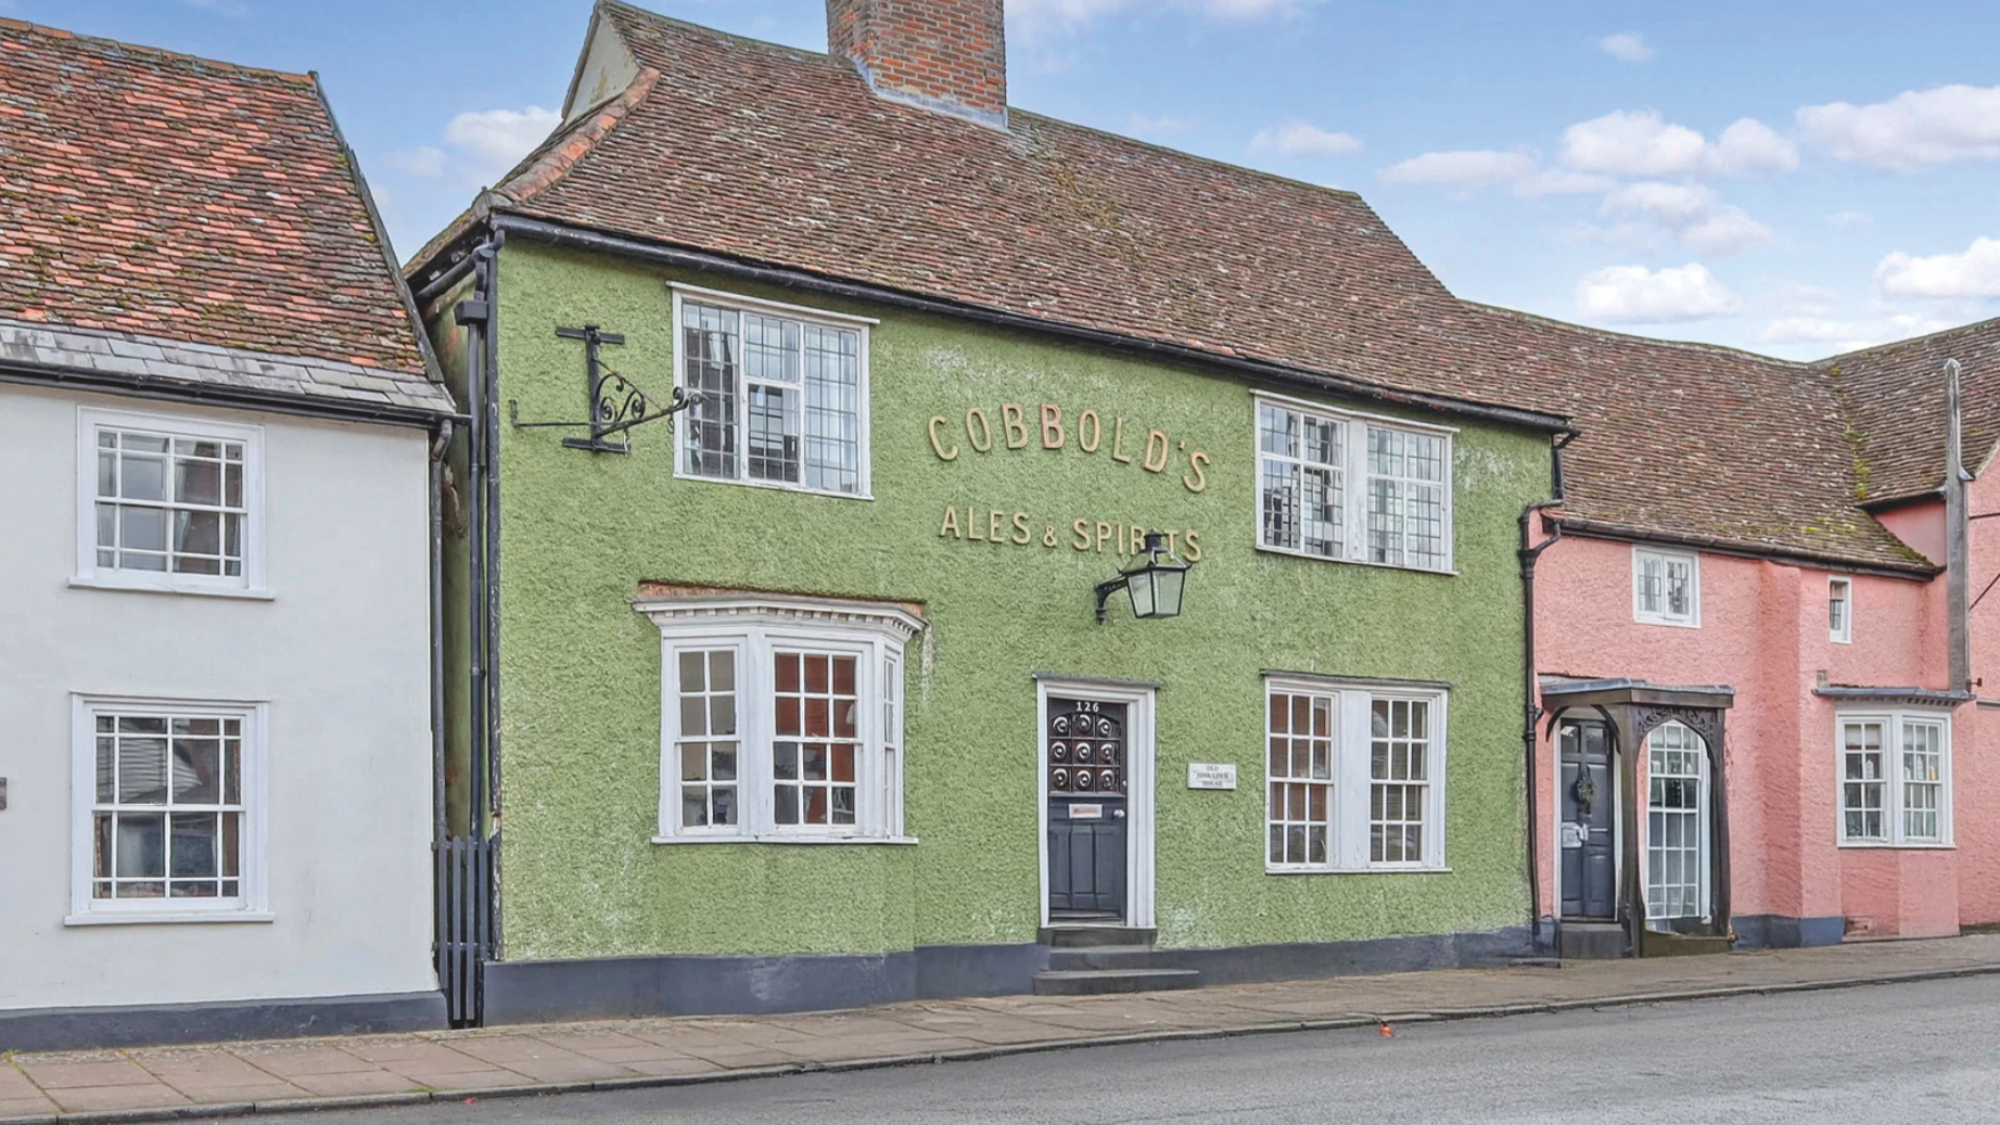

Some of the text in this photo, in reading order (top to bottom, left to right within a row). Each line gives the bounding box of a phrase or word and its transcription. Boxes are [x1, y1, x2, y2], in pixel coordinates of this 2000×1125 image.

[929, 403, 1210, 492] COBBOLD'S
[940, 505, 1201, 562] ALES & SPIRTS
[1076, 701, 1099, 713] 126
